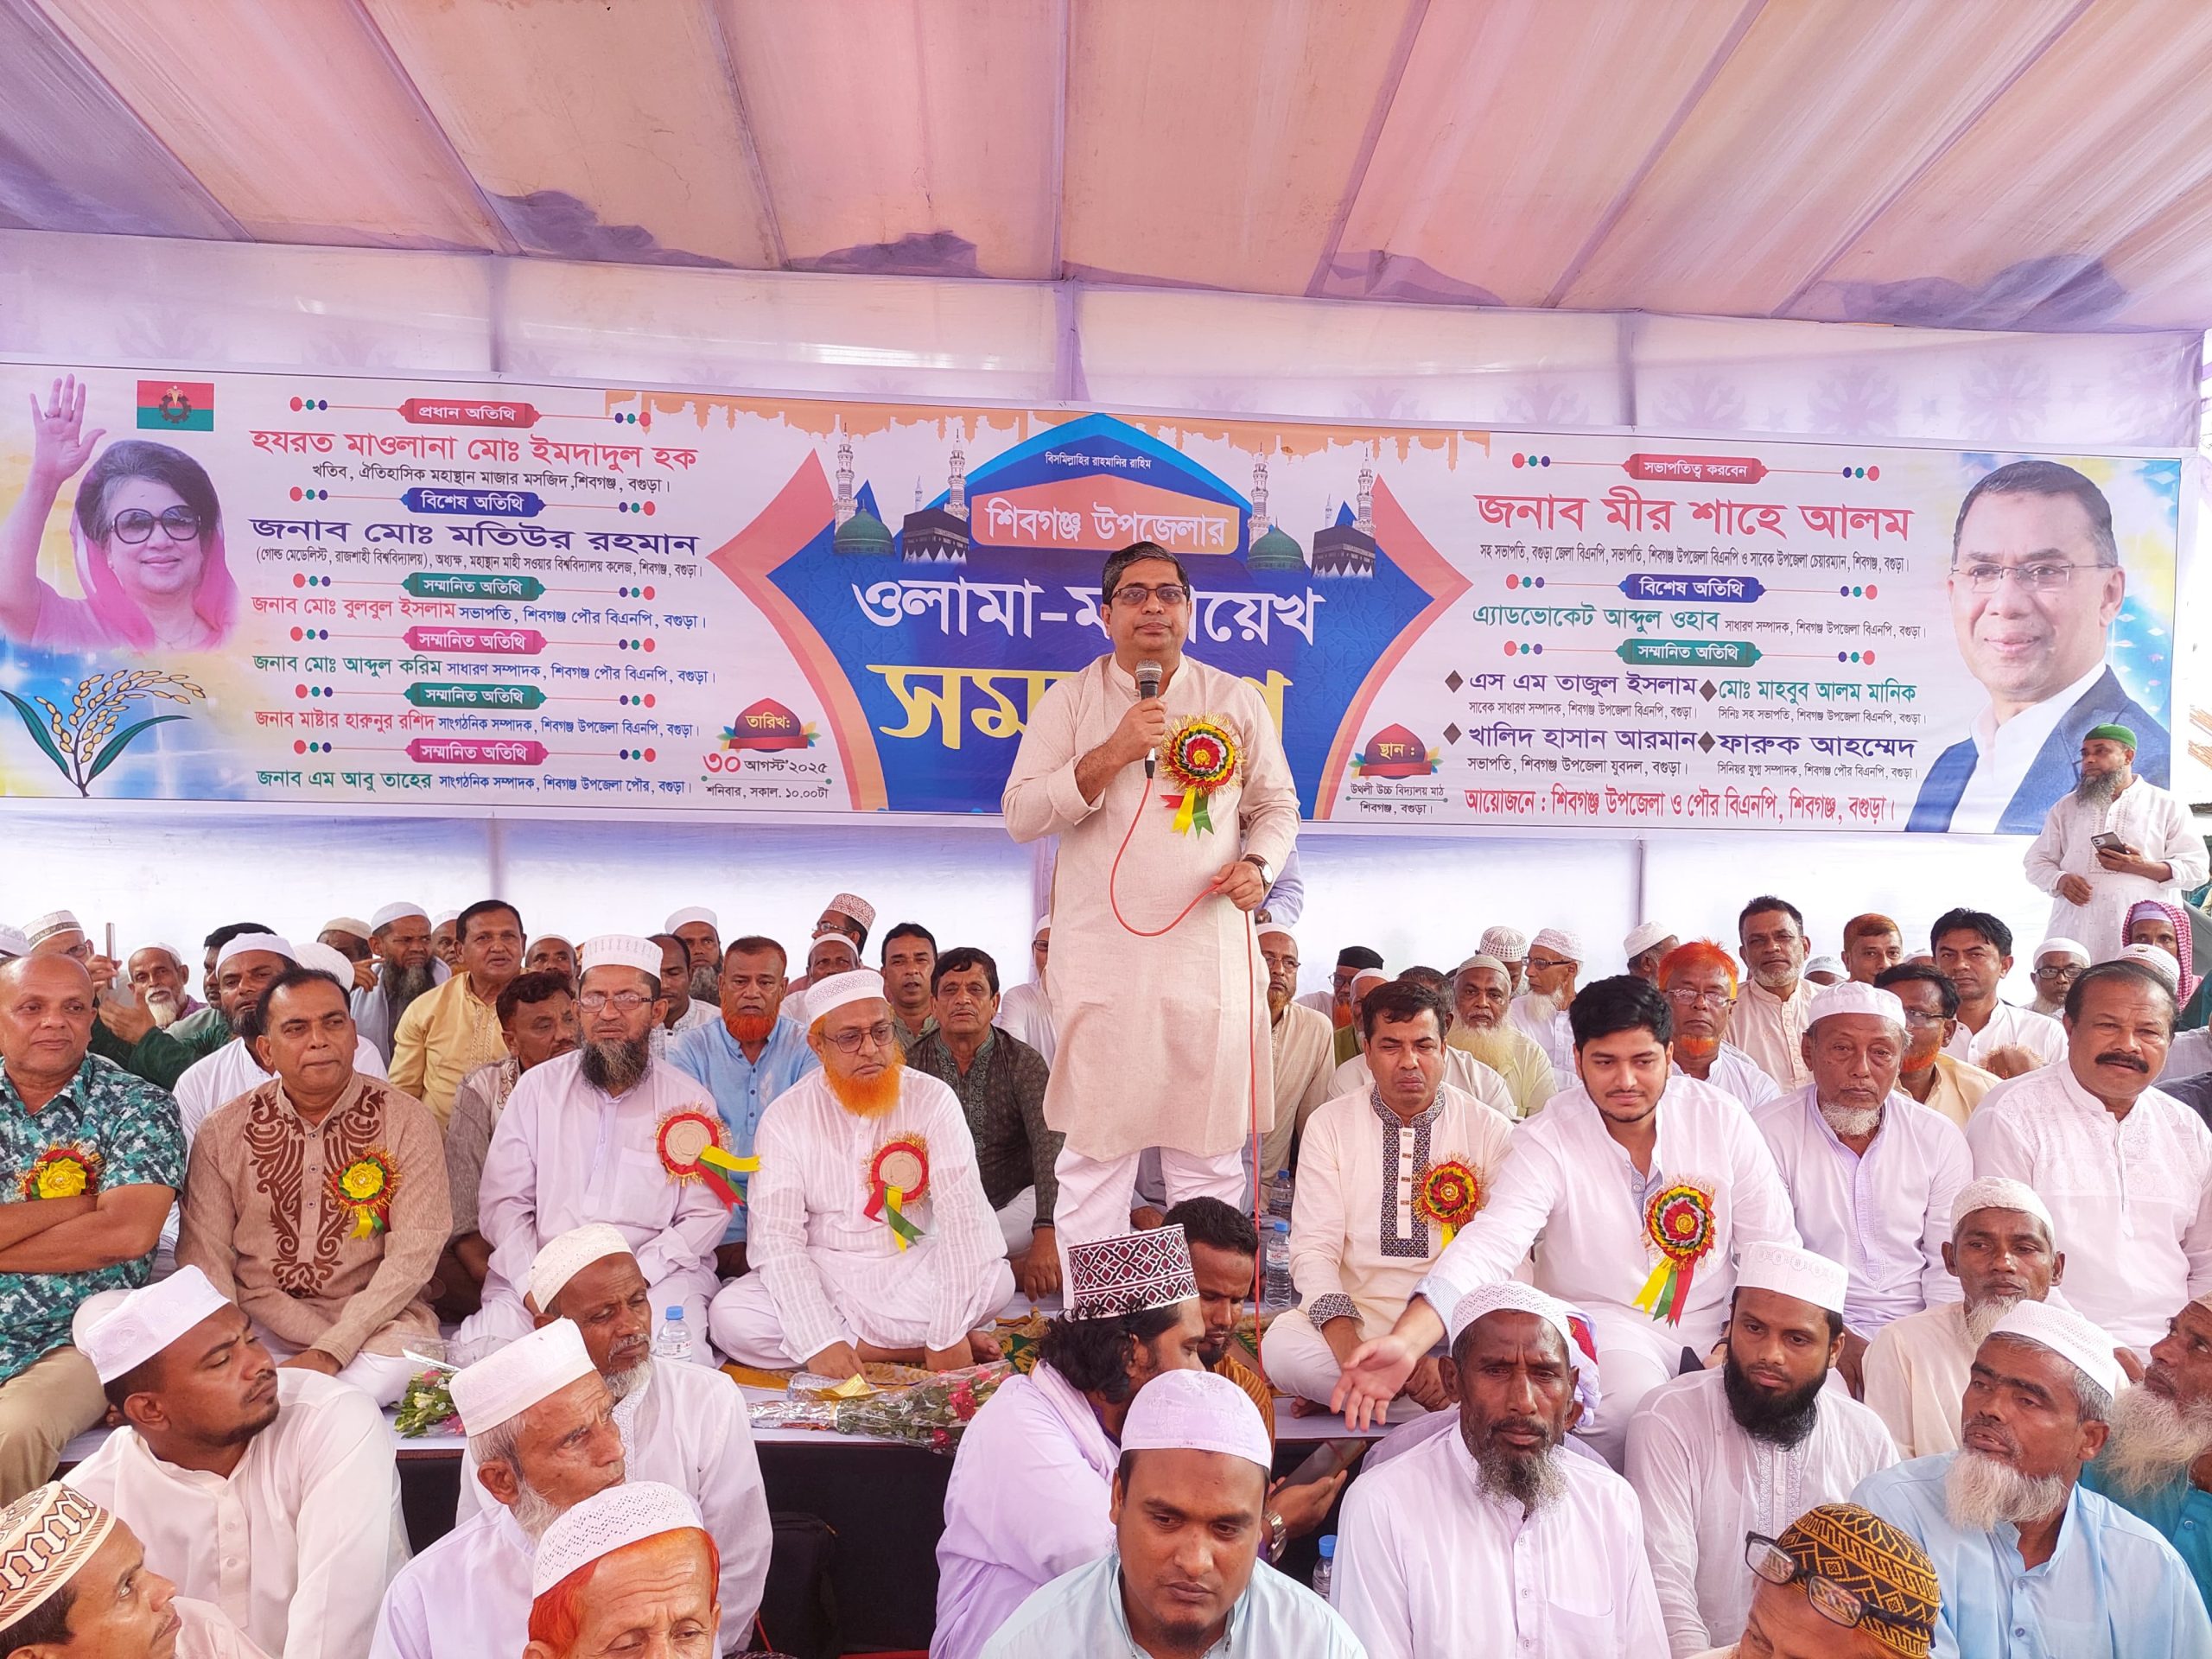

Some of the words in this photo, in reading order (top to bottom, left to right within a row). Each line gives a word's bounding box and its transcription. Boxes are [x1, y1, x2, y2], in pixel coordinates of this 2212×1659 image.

[418, 405, 461, 419] প্রধান
[464, 404, 517, 422] অতিথি
[248, 429, 338, 455] হযরত
[342, 432, 460, 461] মাওলানা
[467, 437, 520, 462] মোঃ
[527, 434, 645, 472] ইমদাদুল
[649, 447, 699, 472] হক
[1643, 460, 1703, 480] সভাপতিত্ব
[1705, 464, 1749, 478] করবেন
[419, 491, 468, 512] বিশেষ
[472, 493, 524, 514] অতিথি
[1473, 493, 1591, 533] জনাব
[1599, 485, 1679, 534] মীর
[1688, 497, 1789, 540] শাহে
[1796, 503, 1916, 542] আলম
[984, 497, 1081, 542] শিবগঞ্জ
[1090, 501, 1229, 547] উপজেলার
[248, 518, 353, 543] জনাব
[363, 522, 434, 546] মোঃ
[446, 521, 577, 551] মতিউর
[584, 531, 702, 556] রহমান
[423, 575, 477, 594] সম্মানিত
[479, 577, 524, 595] অতিথি
[1639, 575, 1689, 597] বিশেষ
[1691, 577, 1745, 598] অতিথি
[1601, 607, 1664, 635] আব্দুল
[1669, 609, 1722, 632] ওহাব
[418, 630, 476, 649] সম্মানিত
[479, 632, 527, 651] অতিথি
[1637, 641, 1693, 659] সম্মানিত
[1694, 643, 1740, 661] অতিথি
[423, 687, 479, 703] সম্মানিত
[480, 689, 524, 705] অতিথি
[1469, 673, 1507, 691] এস
[1512, 674, 1548, 692] এম
[1553, 673, 1620, 698] তাজুল
[1624, 671, 1699, 695] ইসলাম
[1718, 678, 1751, 700] মোঃ
[1755, 679, 1810, 705] মাহবুব
[1814, 680, 1863, 702] আলম
[1866, 677, 1917, 704] মানিক
[1468, 721, 1537, 748] খালিদ
[1540, 727, 1609, 751] হাসান
[1612, 728, 1698, 753] আরমান
[1716, 733, 1803, 756] ফারুক
[420, 741, 478, 760] সম্মানিত
[480, 742, 528, 761] অতিথি
[702, 753, 741, 772] ৩০
[1464, 787, 1536, 816] আয়োজনে
[1550, 782, 1599, 816] শিবগঞ্জ
[1604, 784, 1666, 817] উপজেলা
[1670, 794, 1681, 815] ও
[1687, 785, 1721, 817] পৌর
